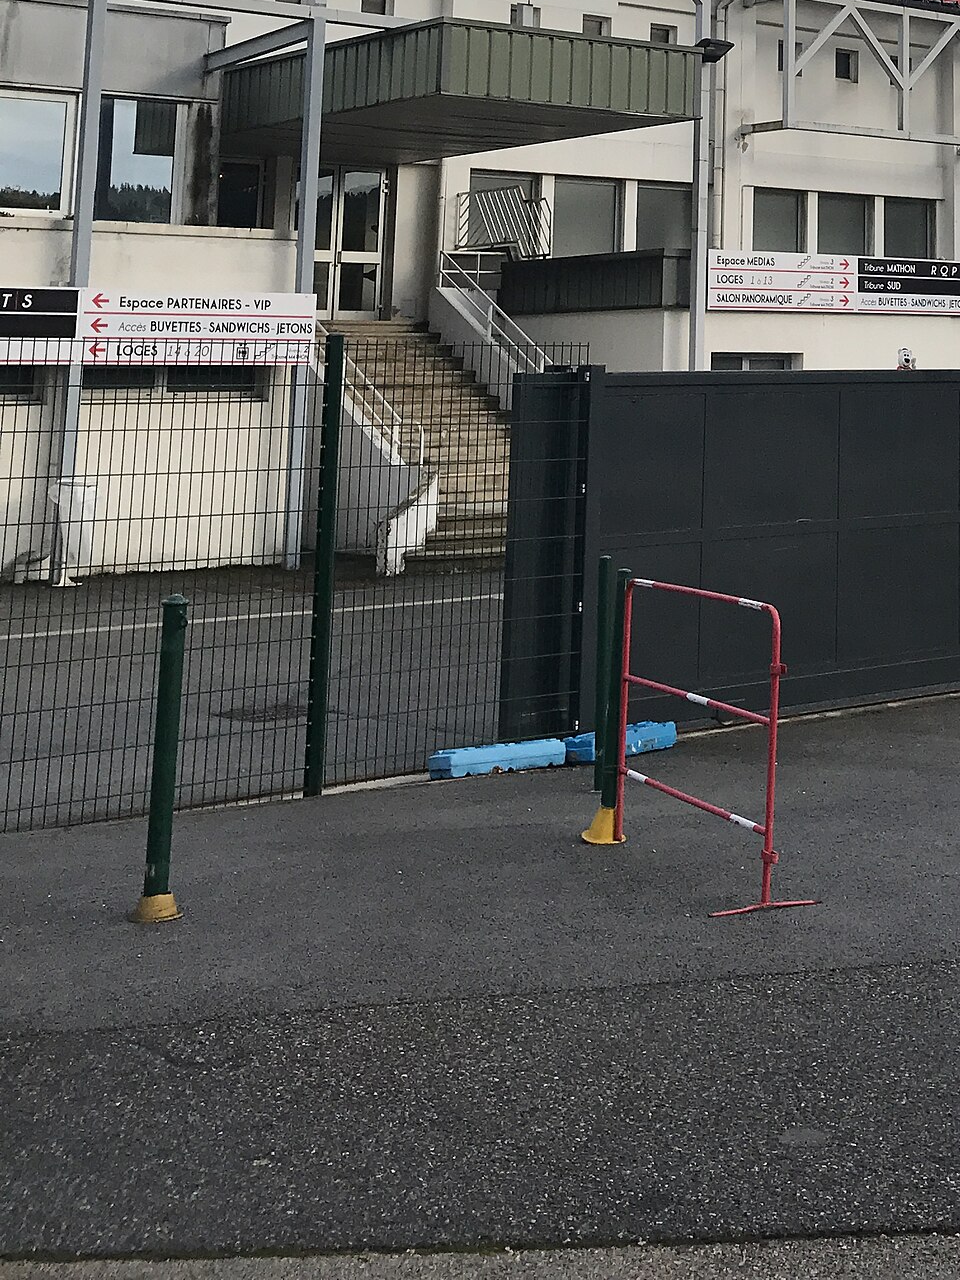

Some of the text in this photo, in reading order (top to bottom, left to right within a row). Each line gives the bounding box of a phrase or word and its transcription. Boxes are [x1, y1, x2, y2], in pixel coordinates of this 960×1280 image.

[717, 256, 745, 267] Espace
[864, 263, 958, 277] Tribune MATHON R Q P
[717, 275, 743, 285] LOGES
[750, 276, 755, 285] 1
[763, 276, 773, 285] 13
[864, 280, 901, 290] Tribune SUD
[2, 294, 12, 308] T
[22, 294, 32, 308] S
[119, 296, 163, 311] Espace
[167, 297, 242, 310] PARTENAIRES
[254, 299, 271, 310] VIP
[716, 293, 793, 305] SALON PANORAMIQUE
[878, 297, 907, 307] BUVETTES
[911, 299, 946, 308] SANDWICHS
[118, 322, 146, 332] Accès
[150, 320, 201, 333] BUVETTES
[209, 322, 270, 333] SANDWICHS
[276, 323, 312, 335] JETONS
[117, 344, 157, 356] LOGES
[194, 345, 210, 357] 20
